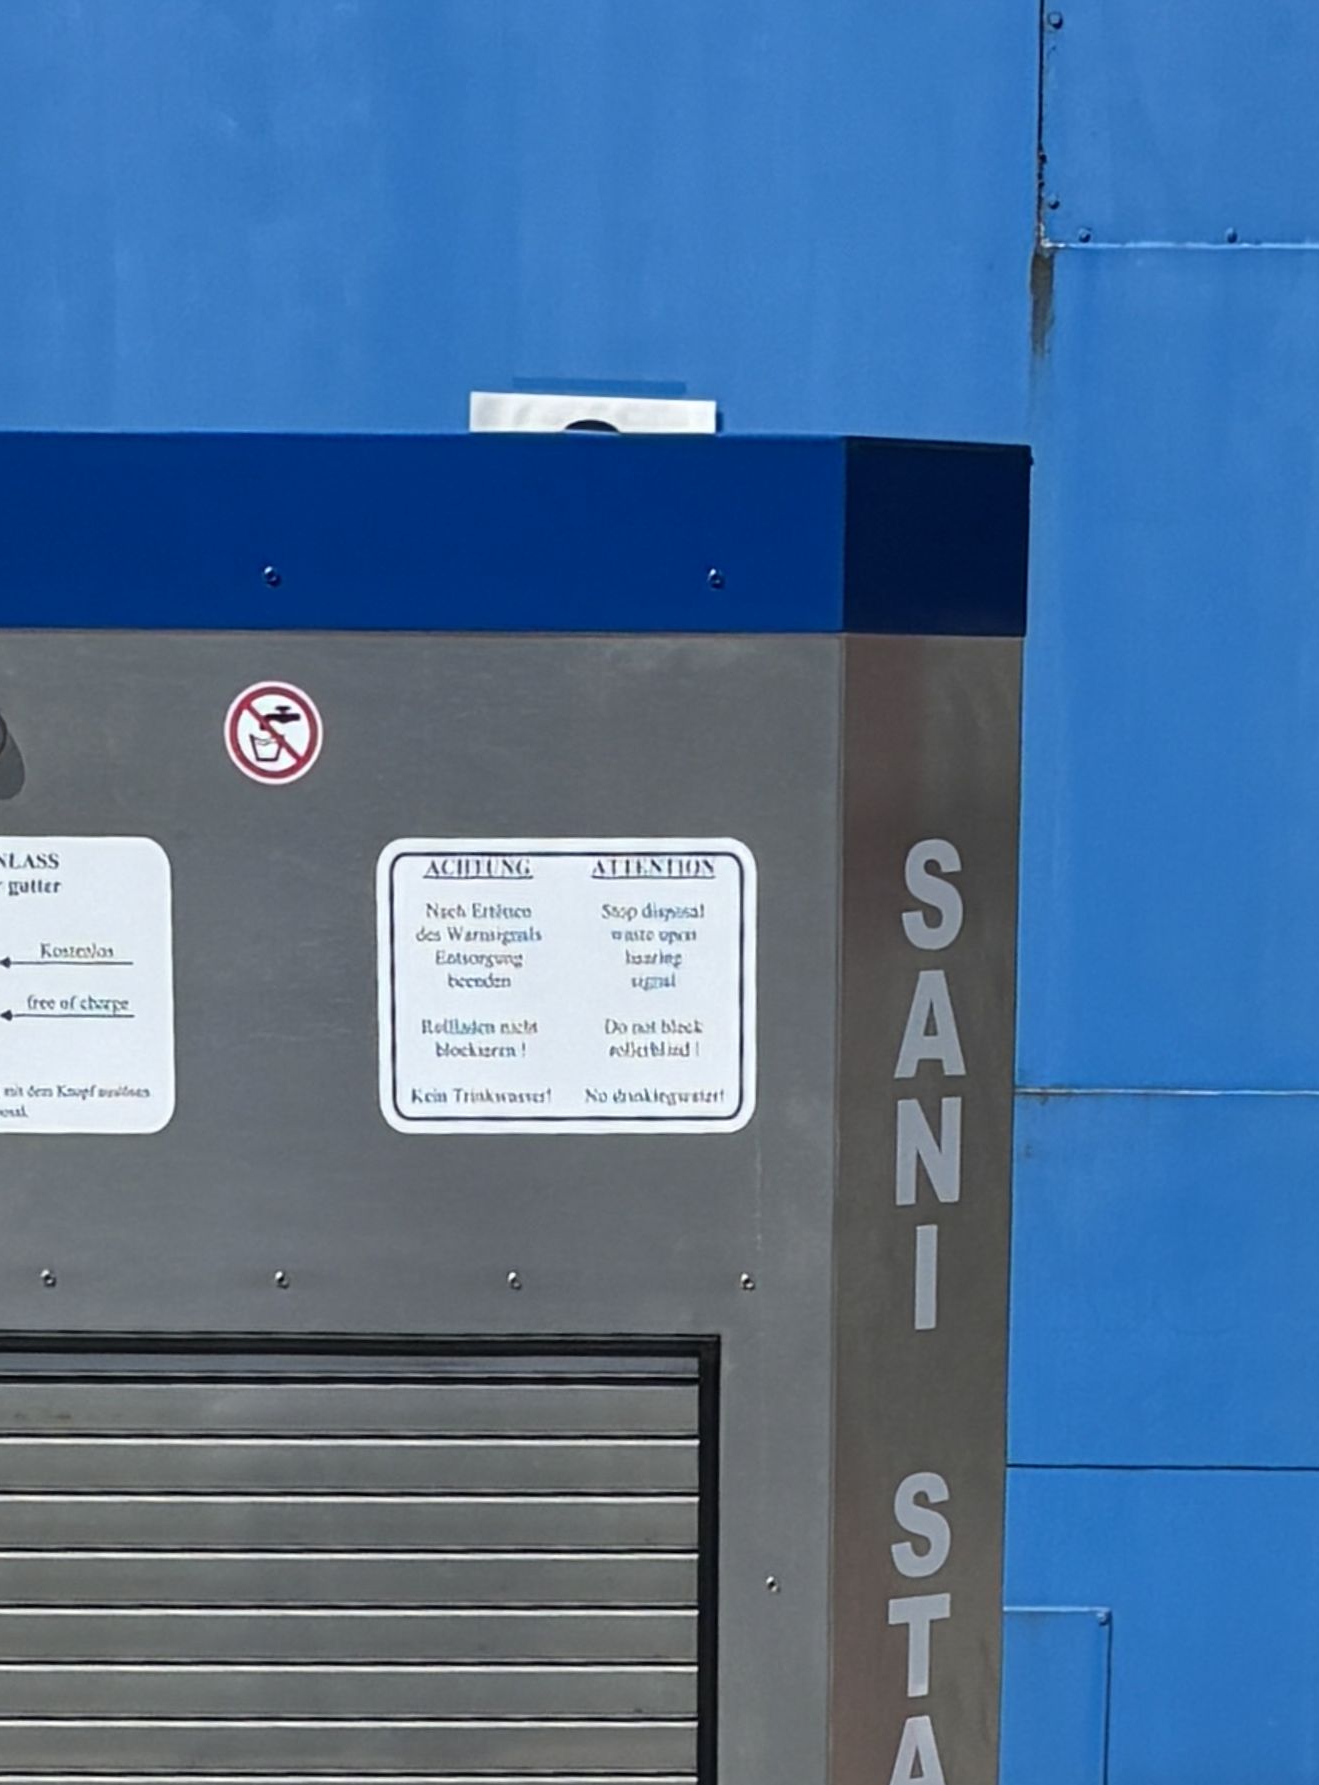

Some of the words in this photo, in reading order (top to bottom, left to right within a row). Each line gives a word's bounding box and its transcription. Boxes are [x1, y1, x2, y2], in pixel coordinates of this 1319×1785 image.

[424, 858, 532, 877] ACHTUNG
[592, 858, 716, 877] ATTENTION
[8, 879, 62, 896] gutter
[426, 902, 466, 919] Nach
[602, 904, 638, 922] Stop
[642, 902, 705, 922] disposal
[415, 926, 442, 942] des
[447, 926, 542, 946] Warnsignals
[40, 942, 114, 959] Kostenlos
[435, 950, 523, 968] Entsorgung
[448, 974, 512, 989] beenden
[27, 994, 56, 1011] free
[59, 994, 78, 1010] of
[80, 994, 129, 1015] charge
[500, 1019, 539, 1034] nicht
[604, 1018, 628, 1035] Do
[661, 1019, 704, 1034] block
[893, 838, 967, 1331] SANI
[411, 1088, 448, 1104] Kein
[585, 1088, 608, 1103] No
